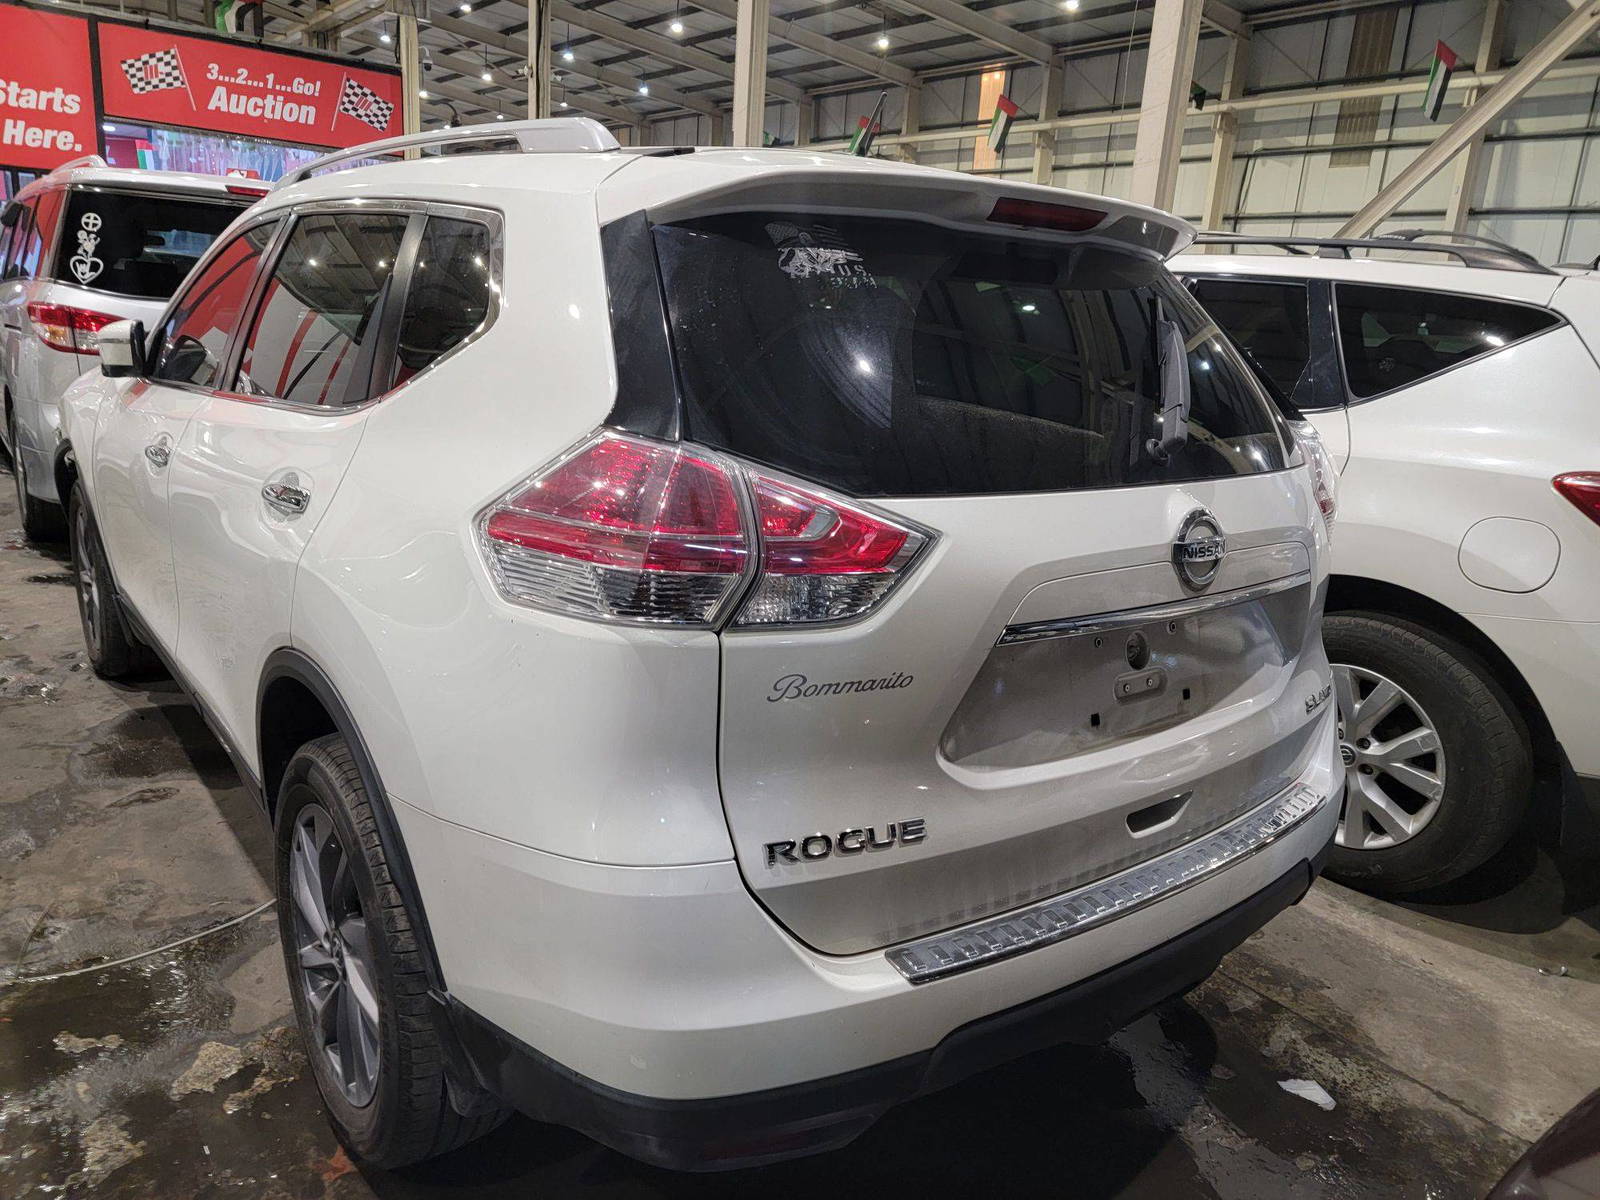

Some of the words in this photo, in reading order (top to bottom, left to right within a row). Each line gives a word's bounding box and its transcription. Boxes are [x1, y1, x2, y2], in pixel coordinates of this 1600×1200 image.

[207, 85, 316, 125] Auction
[3, 119, 82, 152] Here.
[1183, 540, 1226, 560] NISSAN
[767, 671, 914, 702] Bommarito
[763, 817, 927, 867] ROGUE
